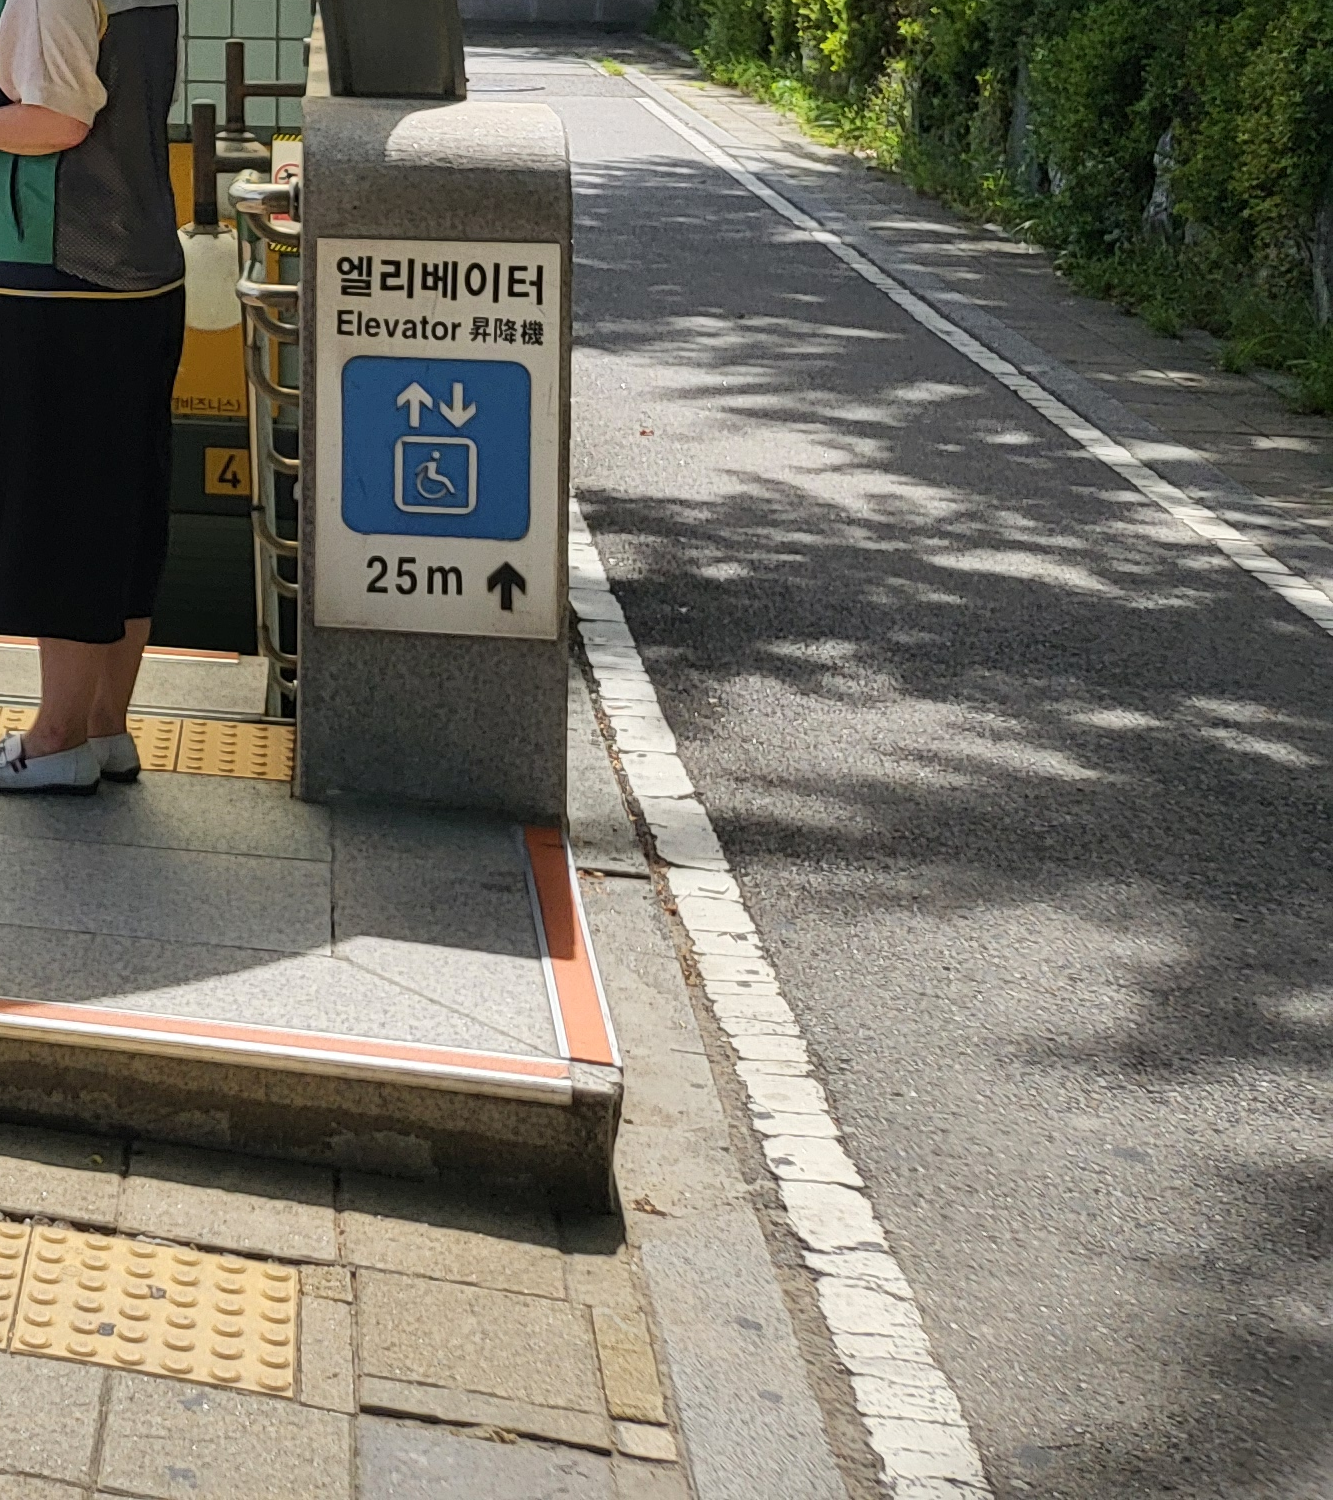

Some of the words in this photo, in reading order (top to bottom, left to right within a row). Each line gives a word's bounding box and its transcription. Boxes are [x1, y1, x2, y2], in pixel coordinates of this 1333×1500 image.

[335, 255, 545, 306] 엘리베이터
[336, 309, 461, 343] Elevator
[468, 316, 545, 346] 昇降機
[217, 453, 241, 489] 4
[366, 555, 463, 596] 25m
